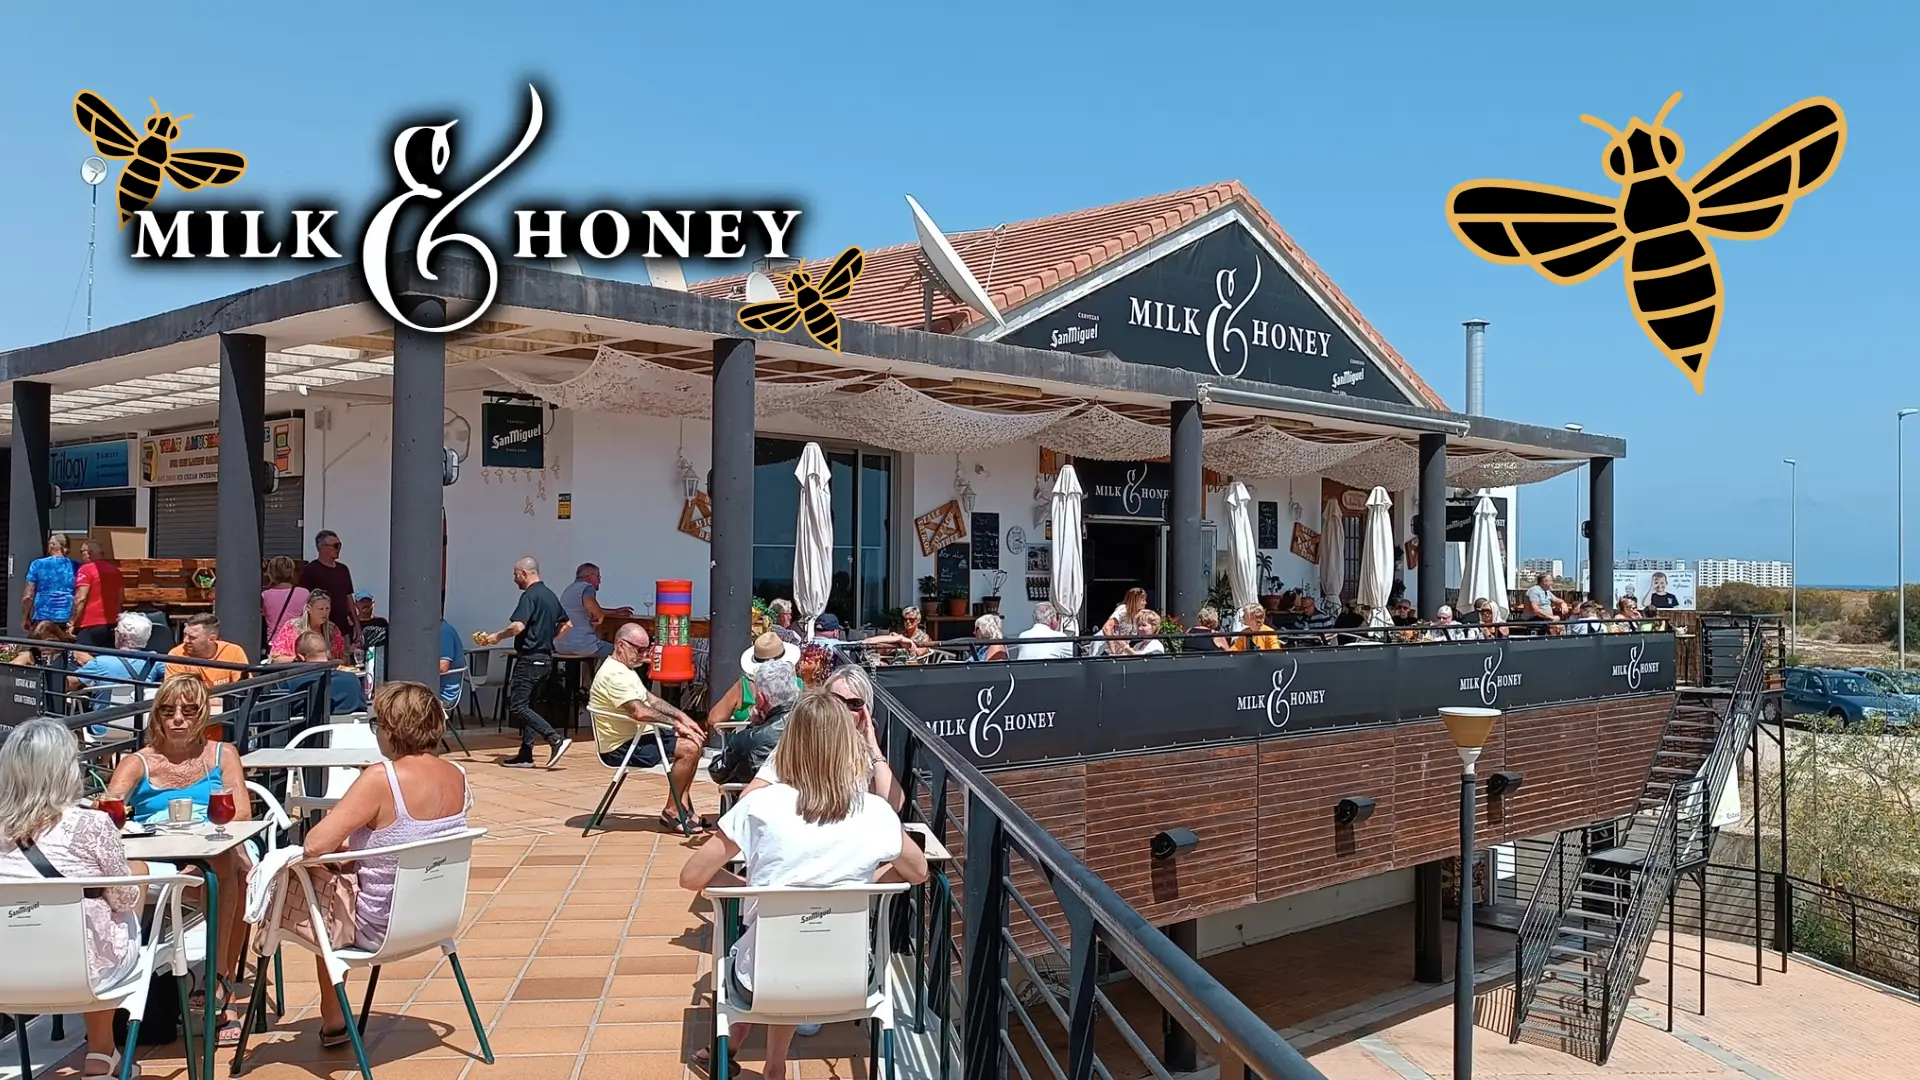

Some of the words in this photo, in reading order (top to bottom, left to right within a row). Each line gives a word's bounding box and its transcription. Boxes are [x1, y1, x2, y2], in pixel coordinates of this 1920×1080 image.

[1128, 297, 1201, 336] MILK
[1206, 254, 1262, 380] &
[1252, 320, 1332, 358] HONEY
[50, 450, 88, 487] Trilogy
[1095, 485, 1122, 497] MILK
[1122, 462, 1148, 515] &
[1237, 694, 1266, 711] MILK
[1266, 657, 1298, 728] &
[1290, 689, 1326, 706] HONEY
[1460, 677, 1480, 691] MILK
[1480, 647, 1503, 705] &
[1496, 673, 1522, 687] HONEY
[1612, 664, 1628, 676] MILK
[1627, 638, 1645, 690] &
[1640, 661, 1660, 674] HONEY
[969, 672, 1015, 758] &
[1004, 711, 1057, 731] HONEY
